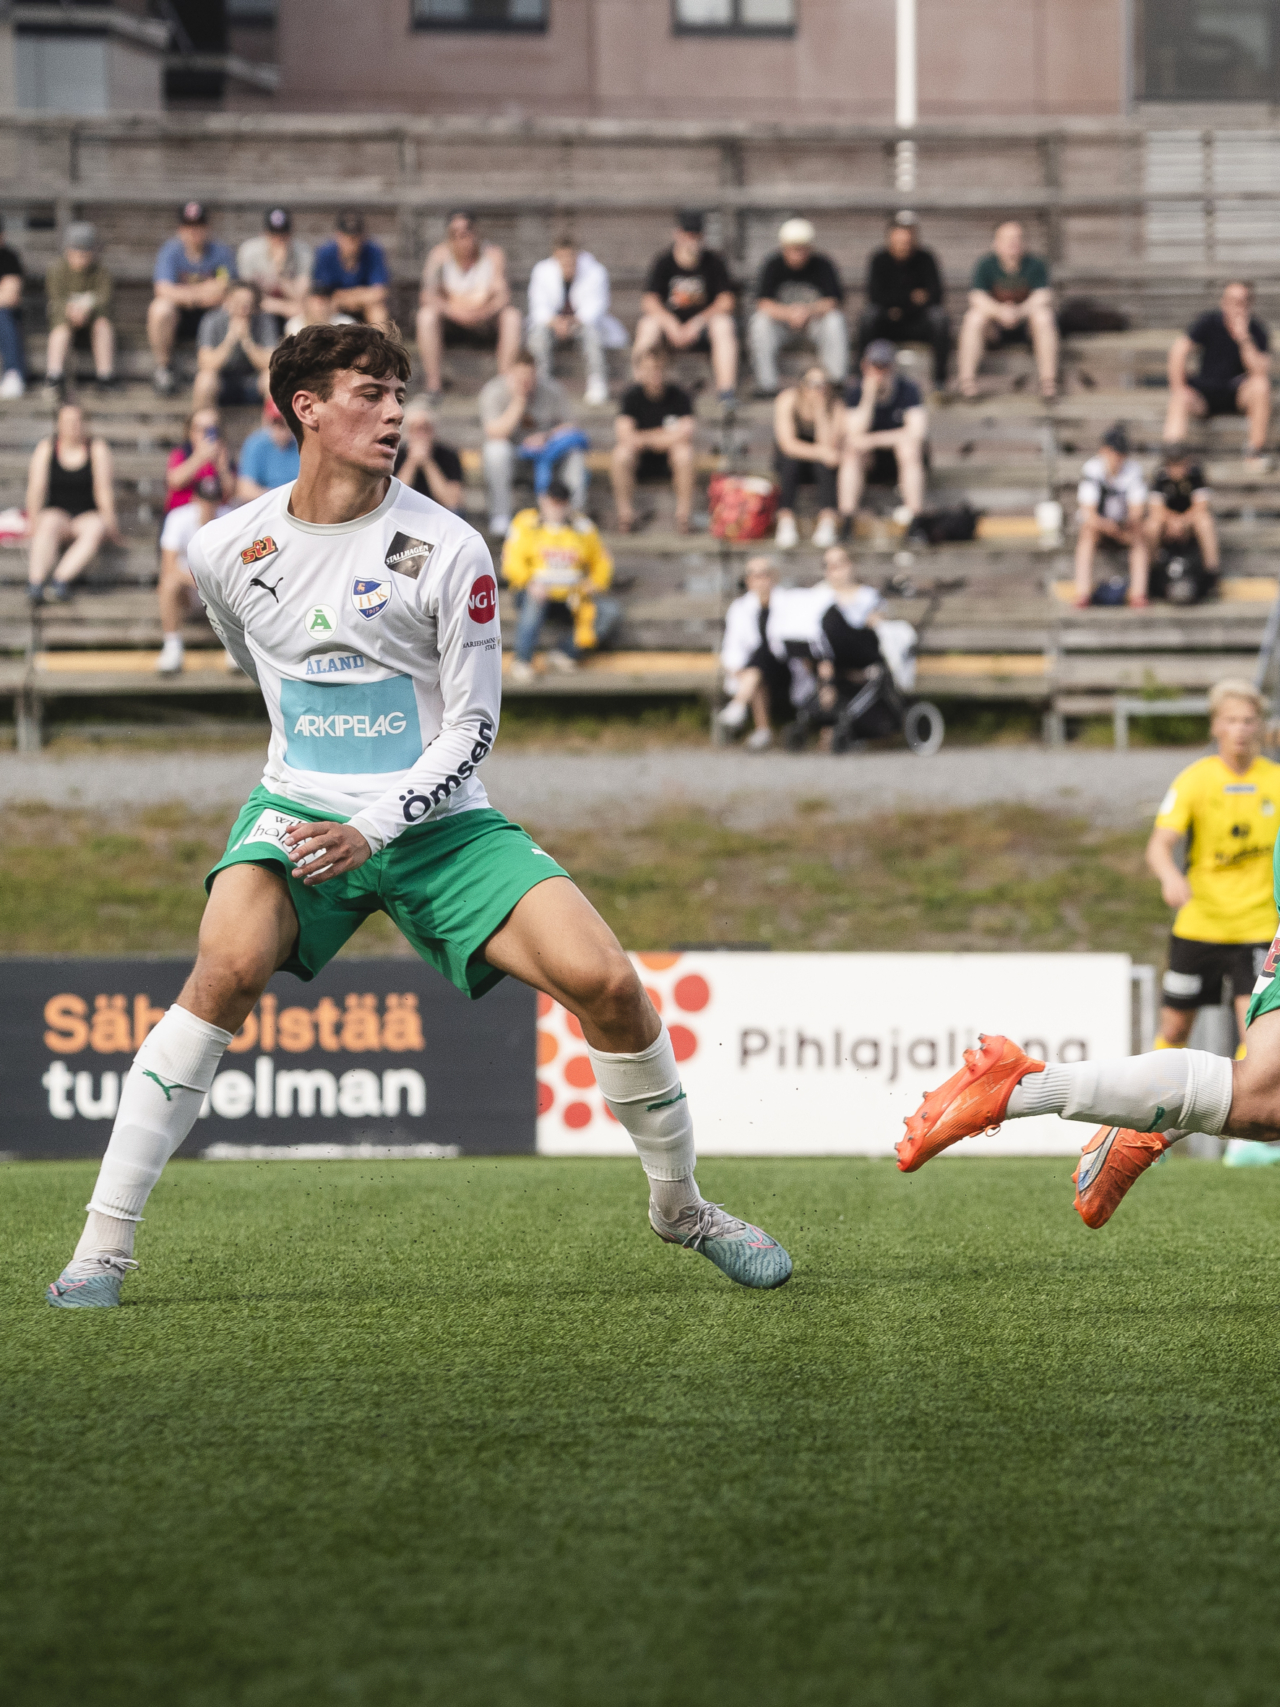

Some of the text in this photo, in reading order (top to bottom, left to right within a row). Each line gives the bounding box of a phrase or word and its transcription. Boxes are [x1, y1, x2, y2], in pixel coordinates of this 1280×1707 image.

[241, 537, 276, 564] st1
[358, 588, 388, 608] IFK
[305, 654, 365, 676] ÅLAND
[293, 711, 407, 737] ARKIPELAG
[398, 721, 493, 822] Ömsen
[43, 992, 425, 1053] Sähistää
[739, 1026, 1089, 1082] Pihlajalna
[41, 1055, 427, 1120] tuelman
